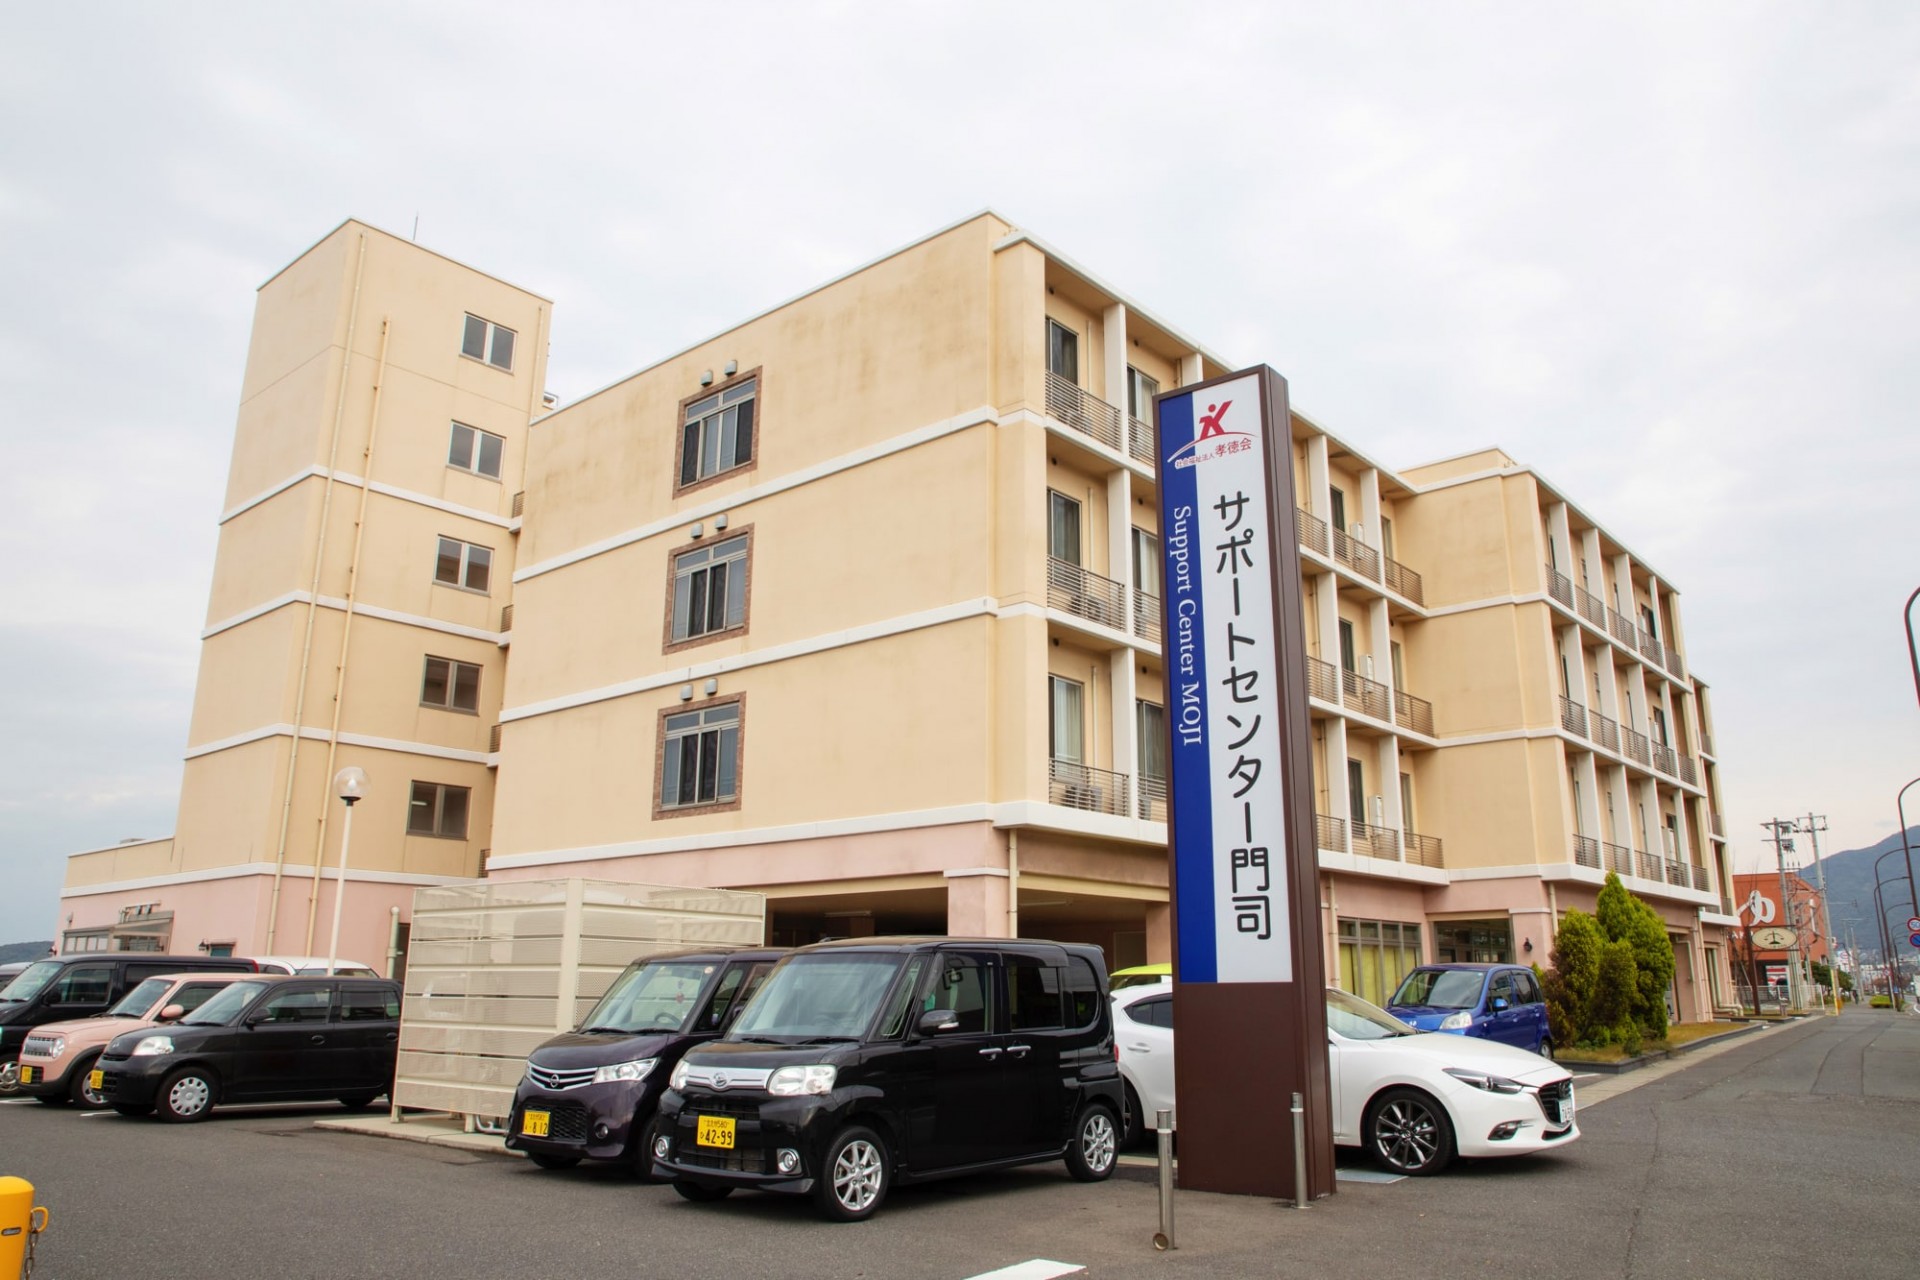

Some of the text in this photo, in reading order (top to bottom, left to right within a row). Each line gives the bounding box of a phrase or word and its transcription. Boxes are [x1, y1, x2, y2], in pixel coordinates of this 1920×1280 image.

[1169, 505, 1202, 746] Support Center MOJI
[1213, 491, 1271, 940] サポートセンター門司
[705, 1129, 733, 1145] 42-99
